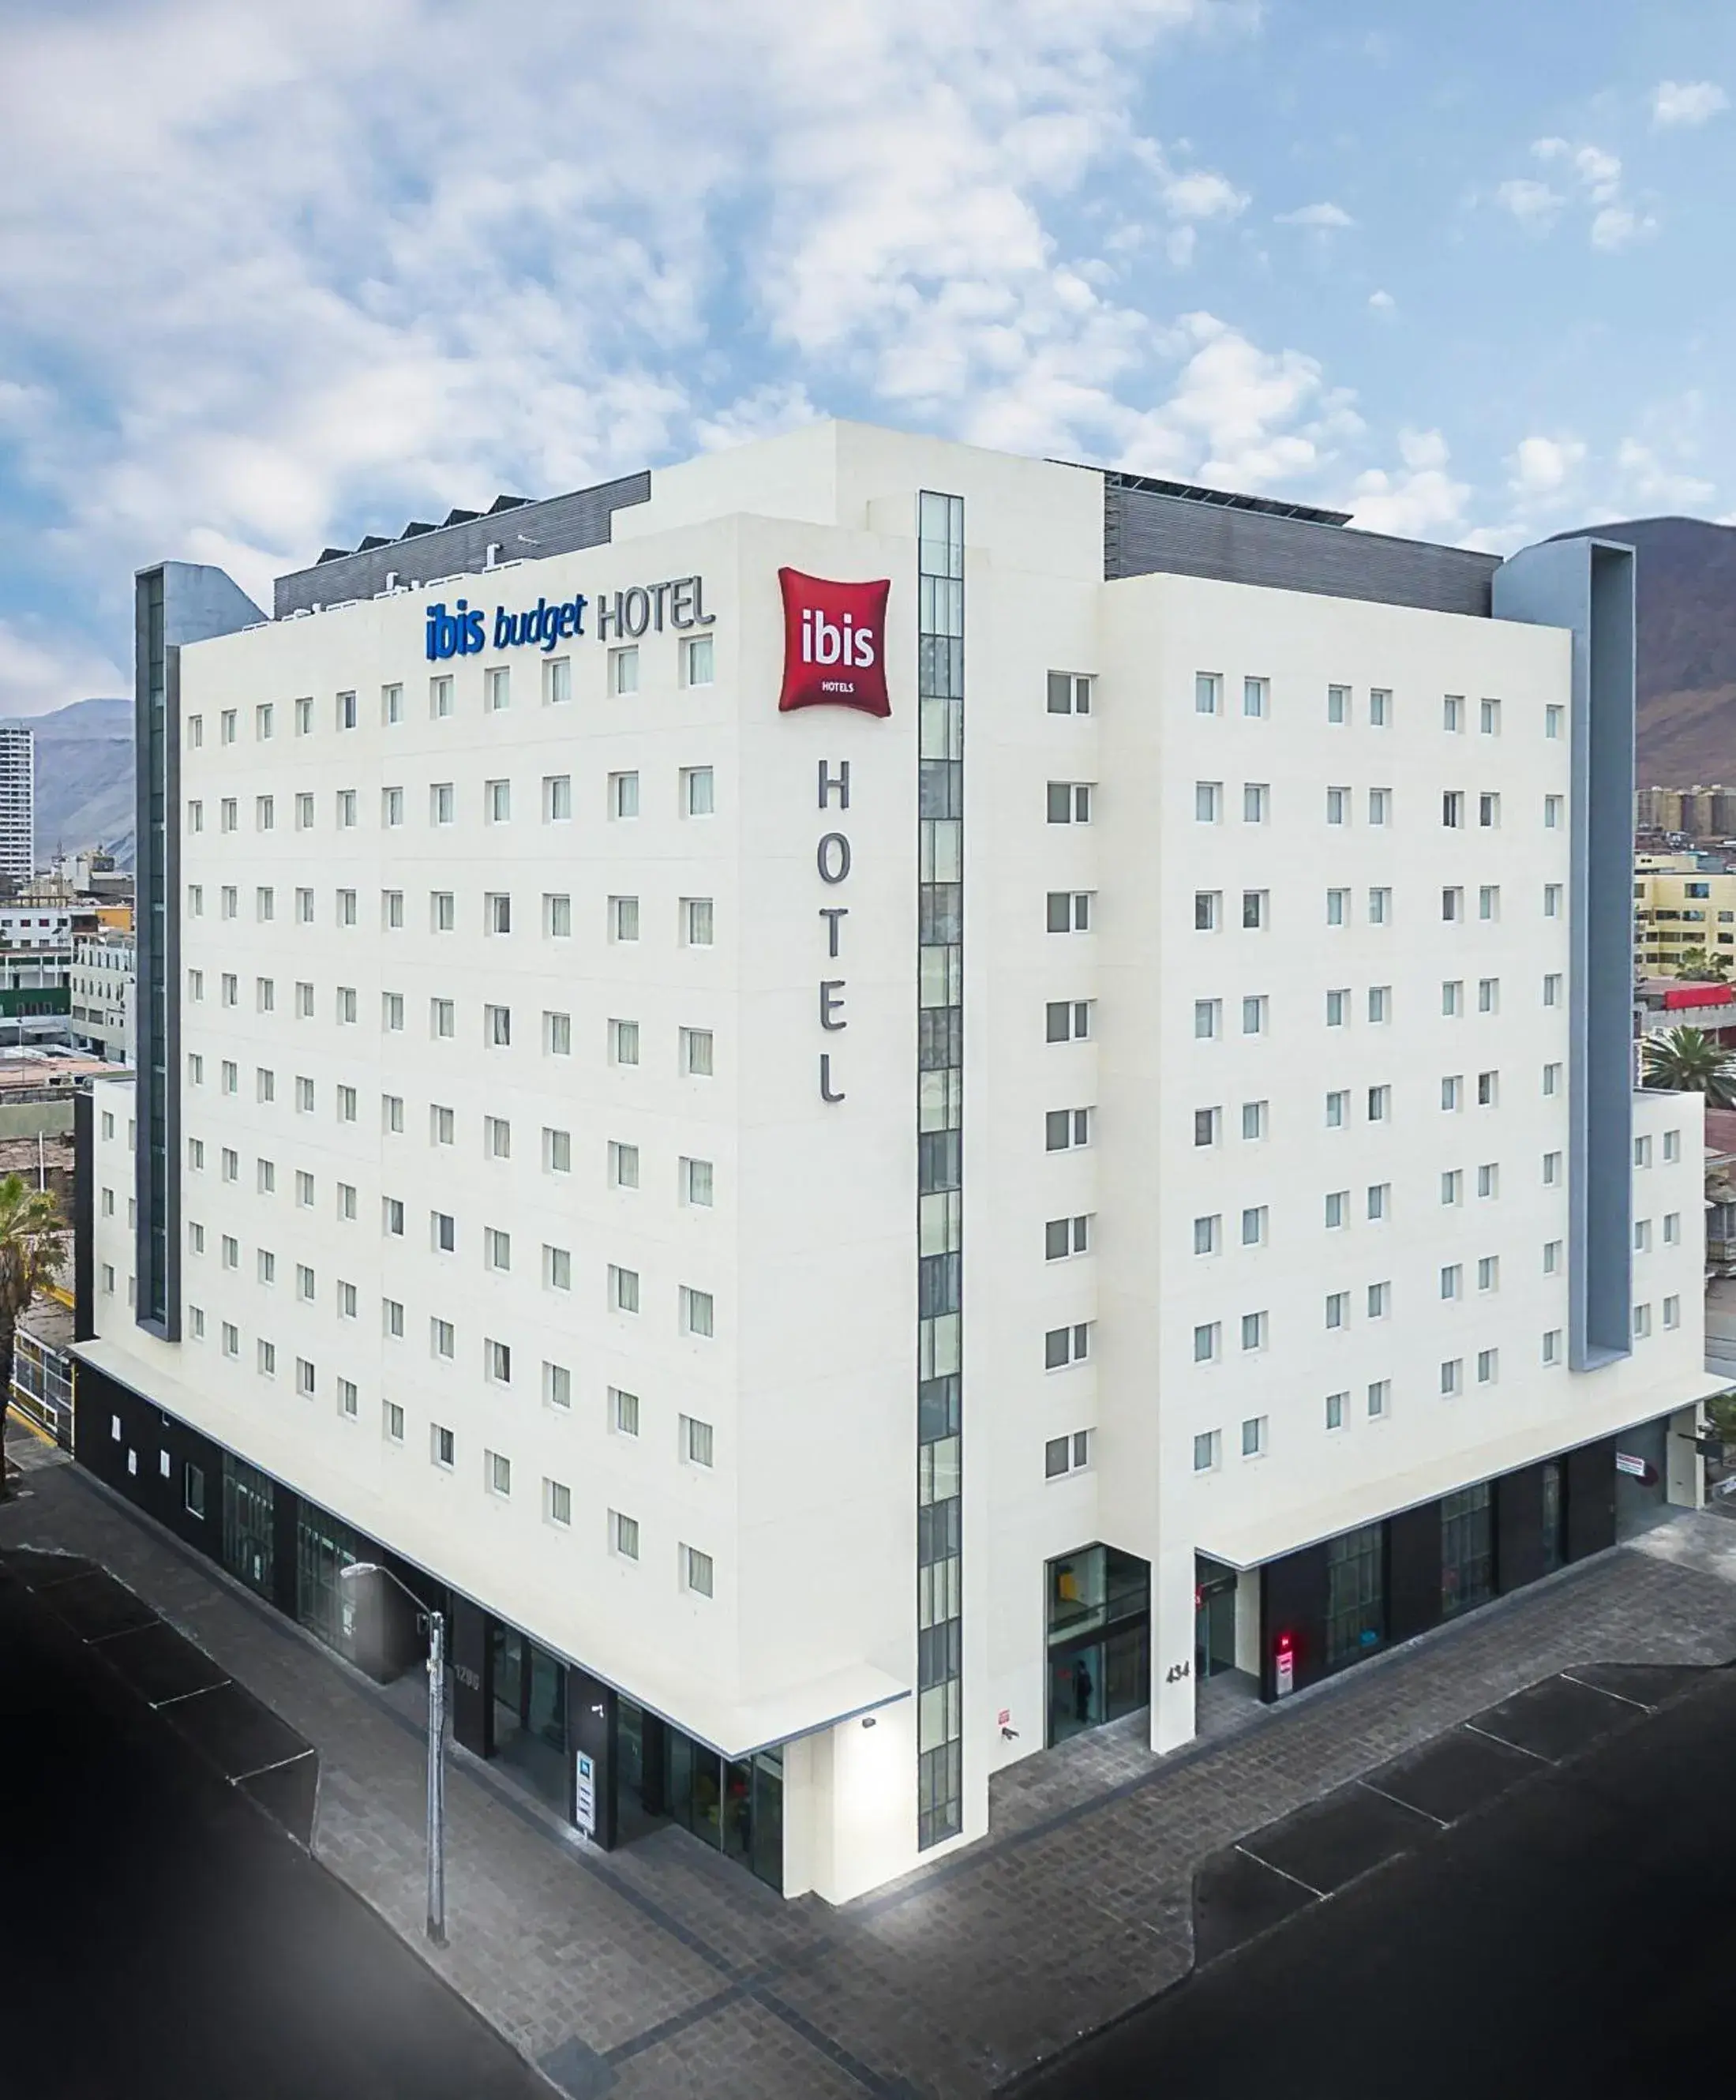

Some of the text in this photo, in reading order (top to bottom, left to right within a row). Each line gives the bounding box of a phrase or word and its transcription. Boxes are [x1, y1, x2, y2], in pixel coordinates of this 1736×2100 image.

[426, 575, 716, 661] ibis budget HOTEL
[802, 609, 875, 668] ibis
[822, 681, 853, 693] HOTELS
[817, 759, 852, 1103] HOTEL
[1166, 1660, 1190, 1684] 434
